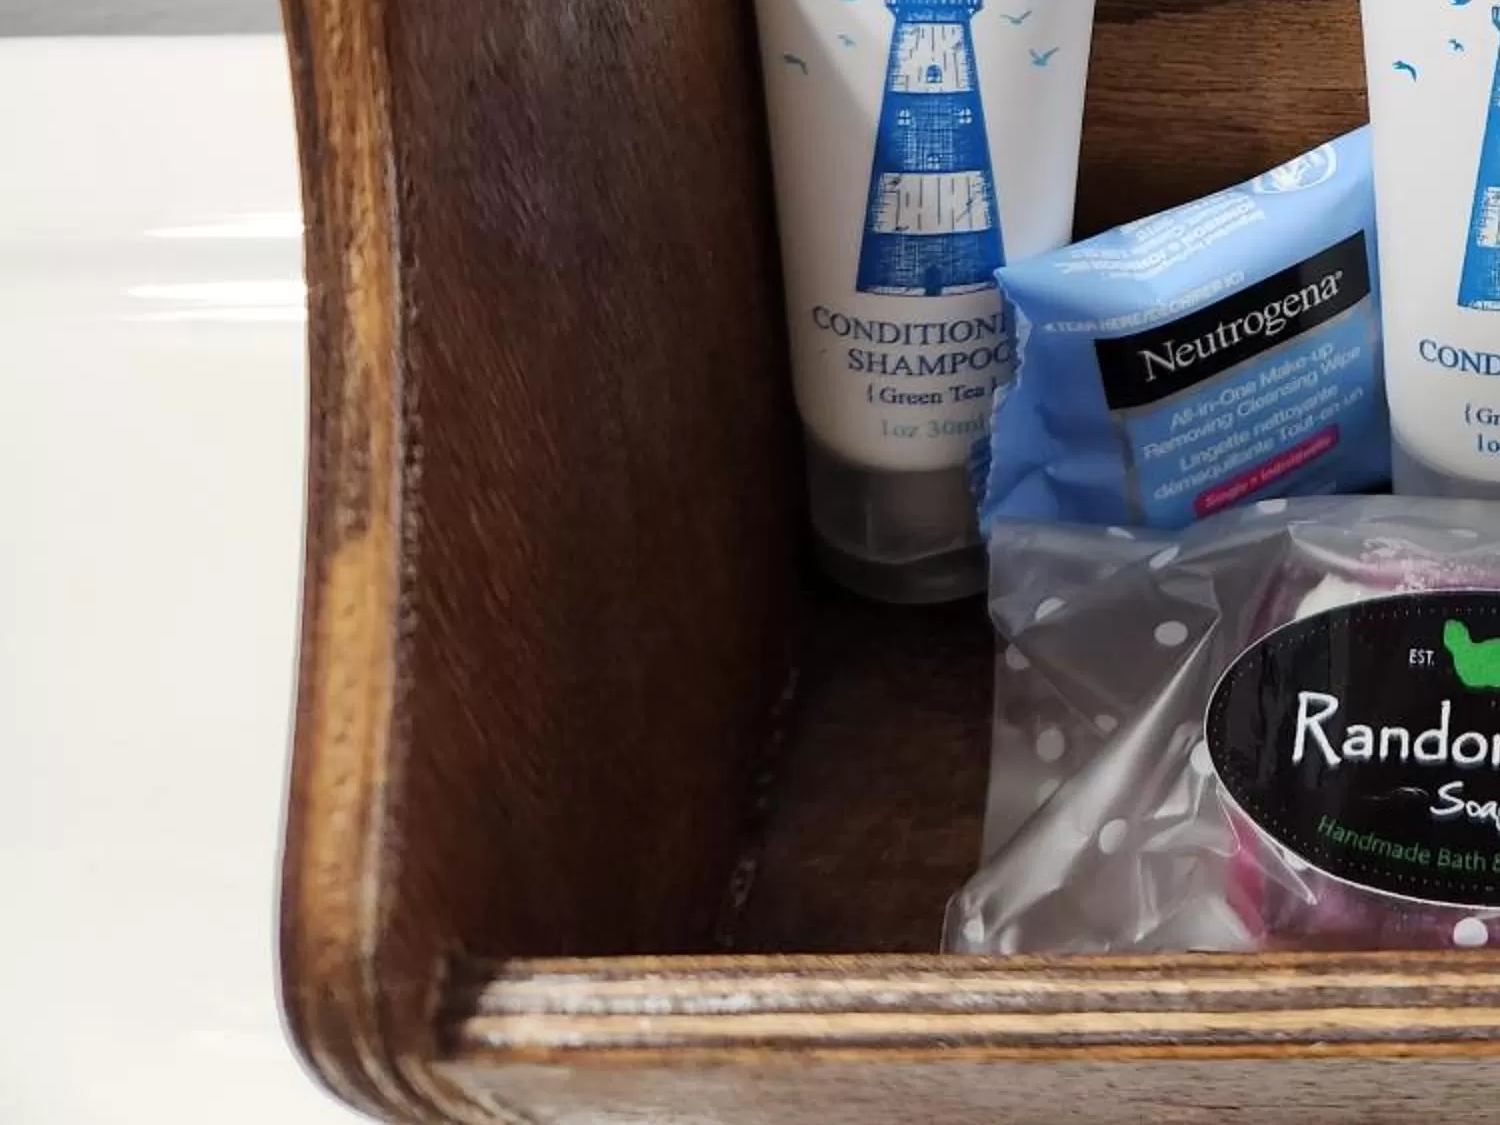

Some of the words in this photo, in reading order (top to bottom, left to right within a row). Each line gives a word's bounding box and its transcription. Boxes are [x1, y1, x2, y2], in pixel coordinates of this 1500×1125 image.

[1136, 271, 1341, 383] Neutrogena
[1259, 343, 1334, 389] Make-up
[1143, 412, 1234, 459] Removing
[1237, 371, 1319, 417] Cleansing
[1320, 346, 1362, 376] Wipe
[1408, 648, 1435, 667] EST.
[1316, 813, 1431, 865] Handmade
[1437, 848, 1486, 872] Bath
